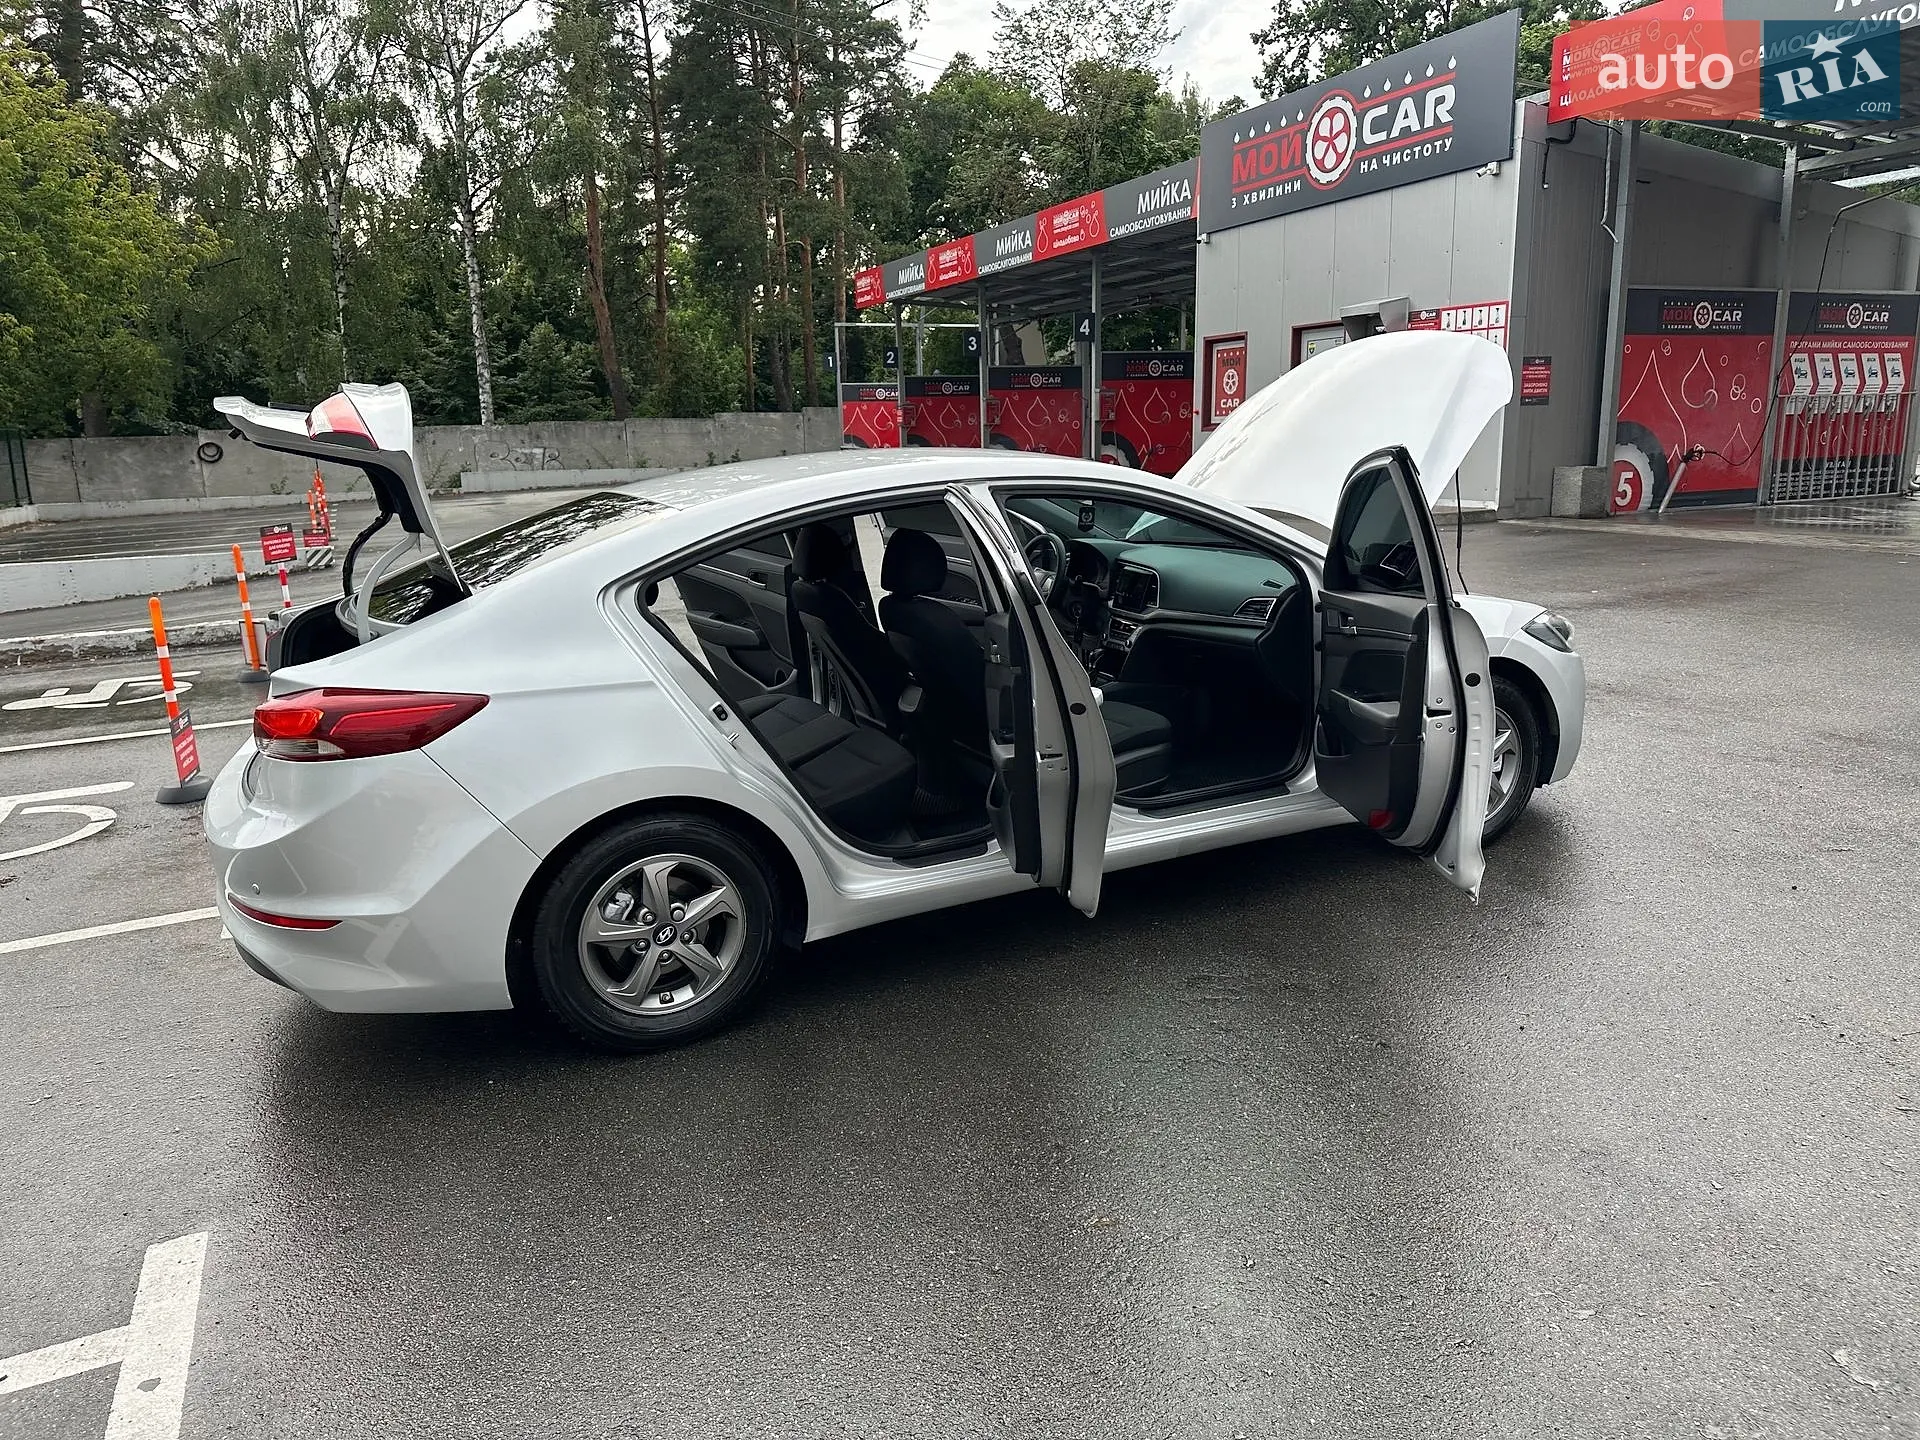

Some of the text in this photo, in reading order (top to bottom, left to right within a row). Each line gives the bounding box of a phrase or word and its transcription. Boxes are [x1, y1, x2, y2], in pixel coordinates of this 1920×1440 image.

[1231, 84, 1457, 185] МОЙ CAR
[1242, 179, 1301, 206] ХВИЛИНИ
[1359, 158, 1379, 174] НА
[1382, 136, 1453, 167] ЧИСТОТУ
[1137, 178, 1192, 215] МИЙКА
[1109, 206, 1191, 238] САМООБСЛУГОВУВАННЯ
[996, 229, 1033, 257] МИЙКА
[898, 262, 925, 285] МИЙКА
[1713, 310, 1742, 322] CAR
[1864, 311, 1890, 323] CAR
[1079, 318, 1090, 336] 4
[968, 336, 977, 350] 3
[827, 356, 833, 368] 1
[886, 351, 895, 364] 2
[1162, 364, 1184, 372] CAR
[1042, 376, 1061, 384] CAR
[1220, 398, 1240, 408] CAR
[1615, 471, 1634, 507] 5
